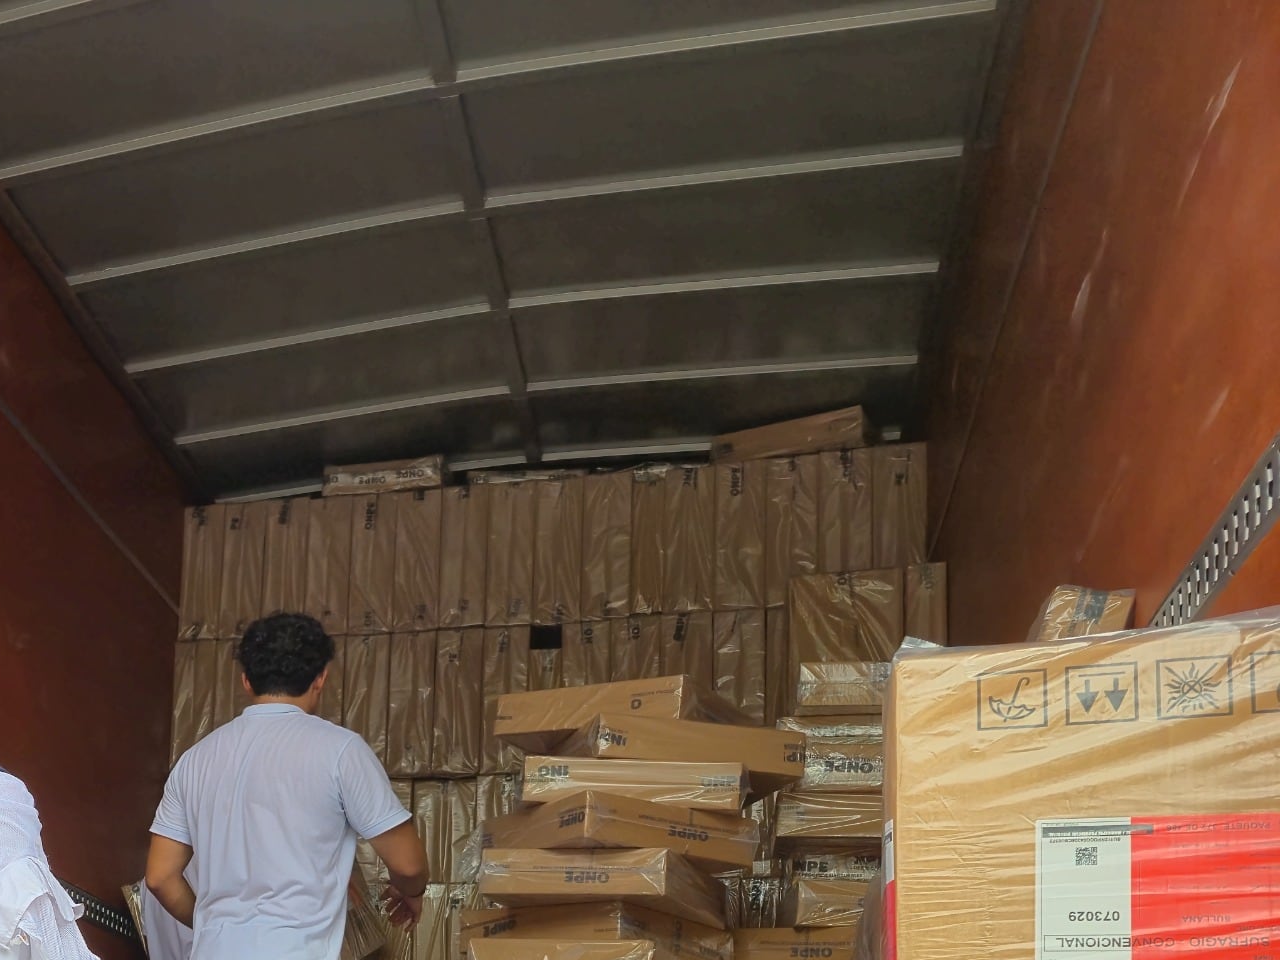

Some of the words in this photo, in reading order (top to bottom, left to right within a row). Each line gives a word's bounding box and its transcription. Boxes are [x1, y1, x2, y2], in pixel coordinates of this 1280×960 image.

[825, 760, 874, 774] ONPE
[564, 871, 610, 884] ONPE
[1068, 910, 1120, 922] 073029
[1055, 936, 1175, 948] CONVENCIONAL
[1189, 936, 1270, 948] SUFRAGIO
[790, 947, 833, 959] ONPE
